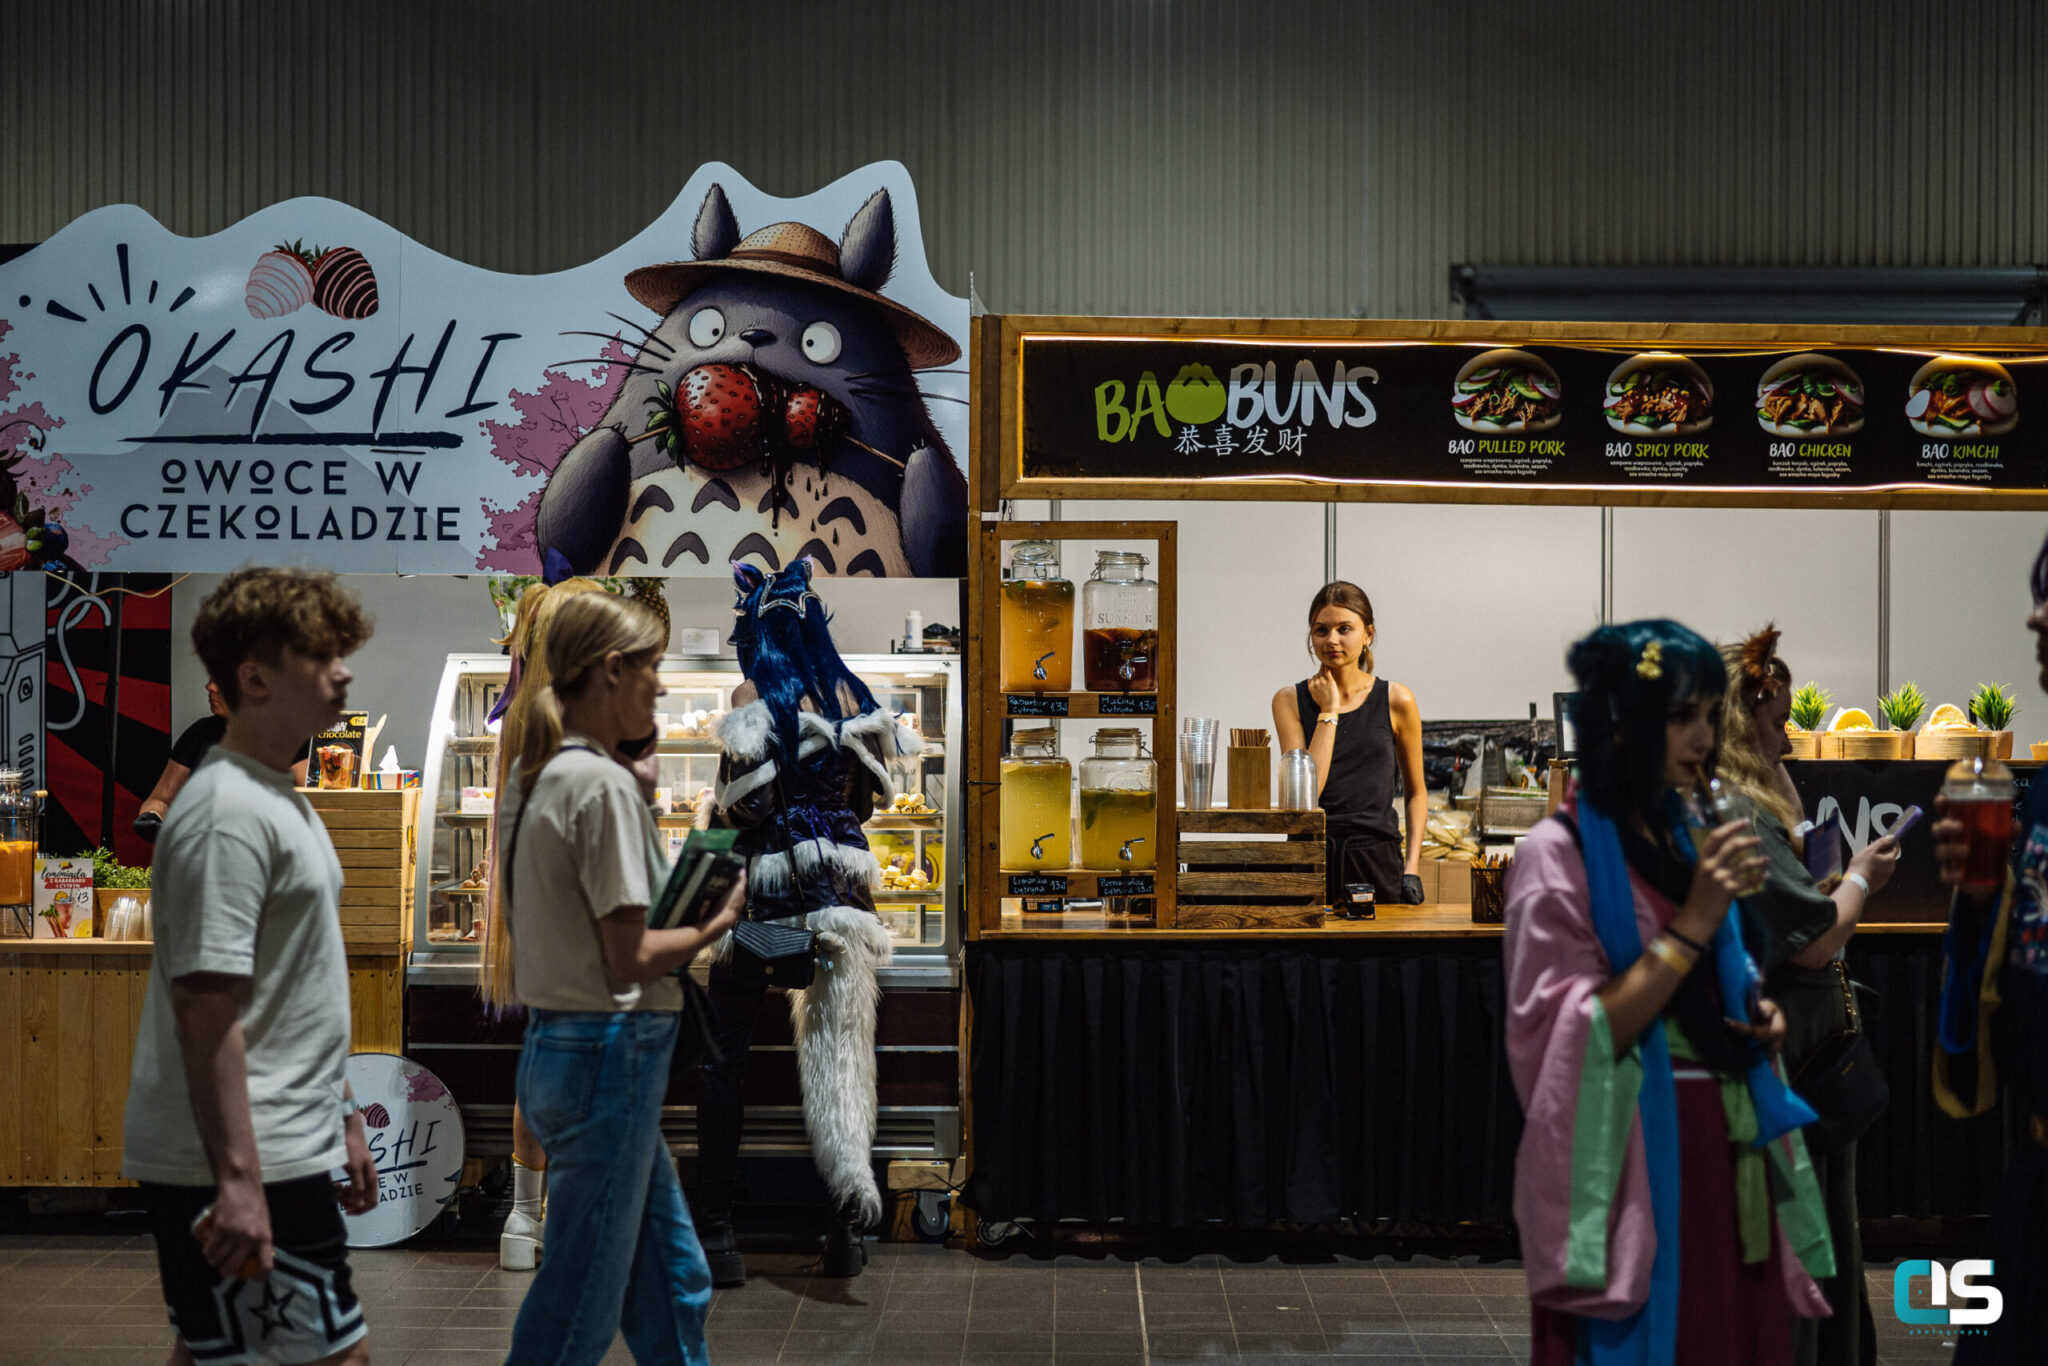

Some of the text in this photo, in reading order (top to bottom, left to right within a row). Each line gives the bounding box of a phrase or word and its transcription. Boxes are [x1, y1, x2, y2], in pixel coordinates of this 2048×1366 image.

[89, 320, 522, 442] OKASHI
[1174, 424, 1308, 456] 恭喜发财
[1448, 440, 1565, 456] BAO PULLED PORK
[1606, 442, 1709, 459] BAO SPICY PORK
[1770, 443, 1852, 458] BAO CHICKEN
[1922, 444, 1999, 459] BAO KIMCHI
[162, 459, 422, 496] OWOCE W
[120, 504, 460, 541] CZEKOLADZIE
[369, 1119, 441, 1168] SHI
[394, 1172, 409, 1185] W
